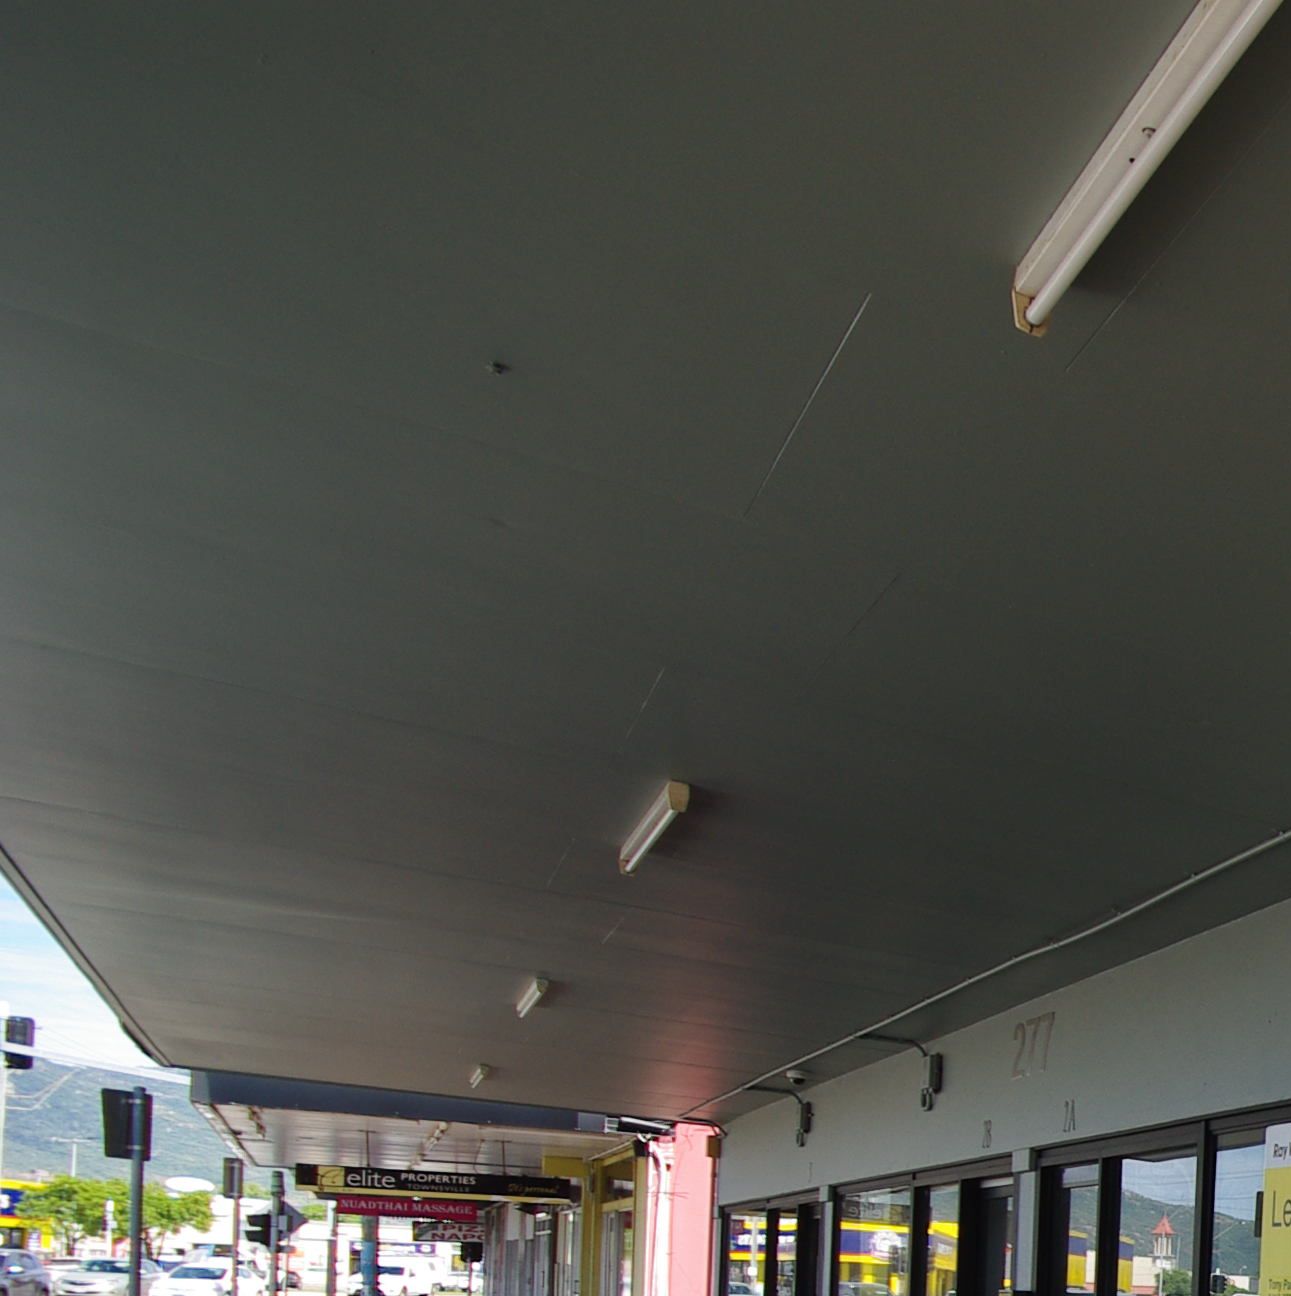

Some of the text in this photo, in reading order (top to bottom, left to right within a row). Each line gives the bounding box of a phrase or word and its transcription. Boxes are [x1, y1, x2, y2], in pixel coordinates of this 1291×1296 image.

[1012, 1011, 1056, 1080] 277
[1273, 1144, 1288, 1160] Ray
[346, 1169, 476, 1189] elite PROPERTIES
[407, 1183, 470, 1193] TOWNSVILLE
[412, 1202, 473, 1215] MASSAGE
[442, 1224, 485, 1233] PIZ
